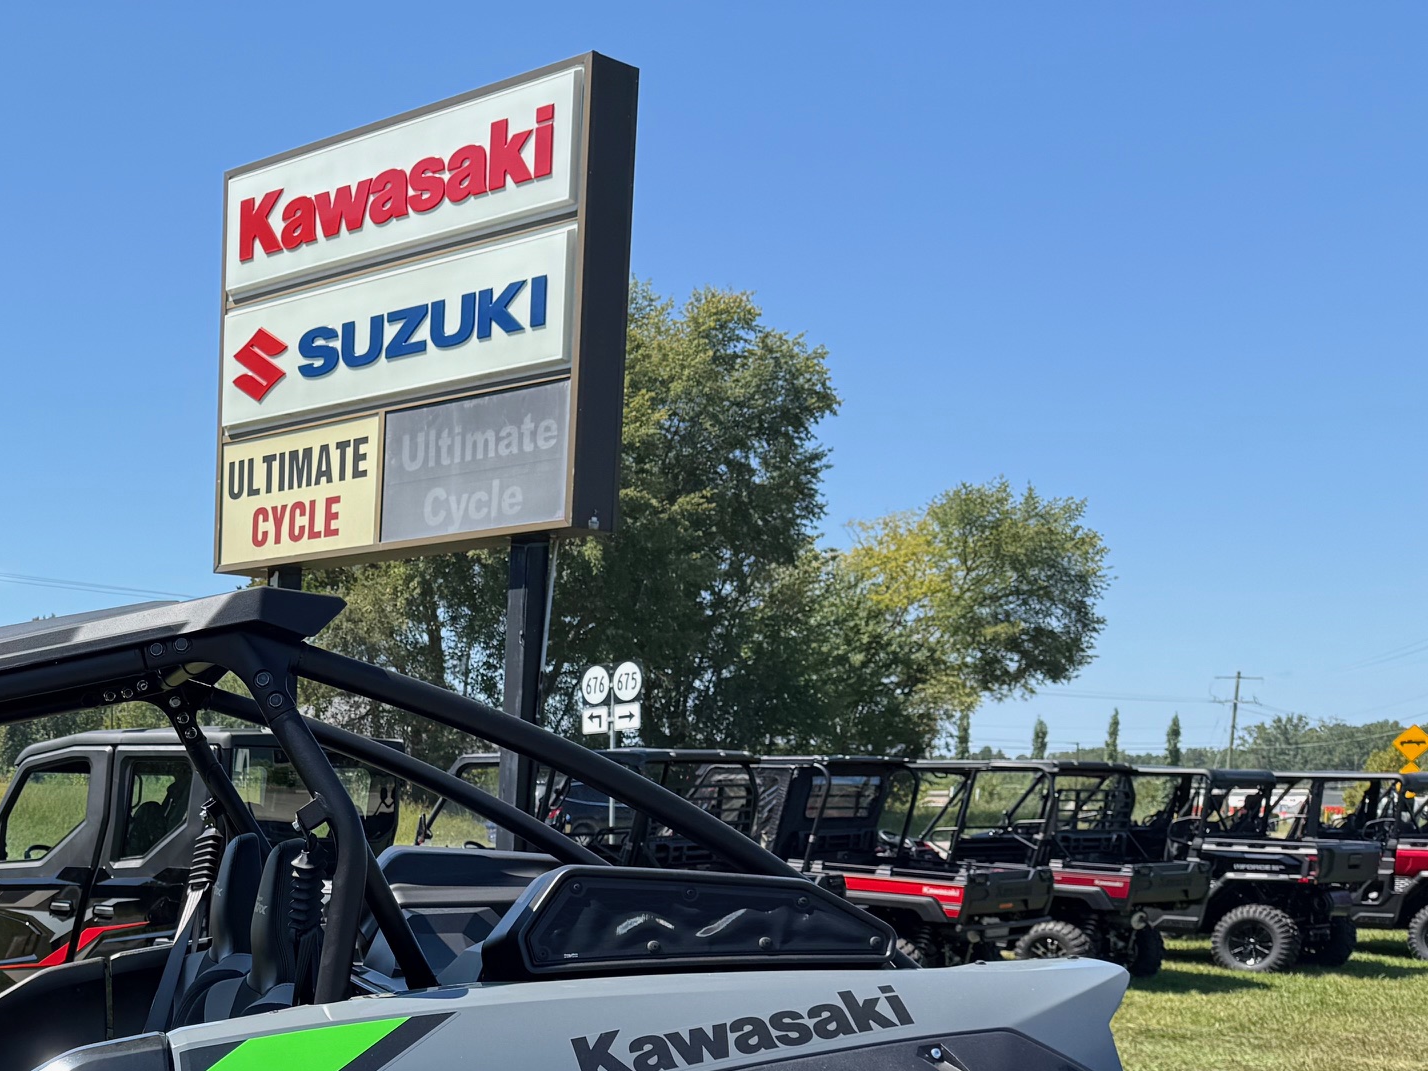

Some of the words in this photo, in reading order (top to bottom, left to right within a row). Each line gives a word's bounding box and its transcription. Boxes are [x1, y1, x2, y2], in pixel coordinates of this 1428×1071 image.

[238, 103, 556, 262] Kawasaki
[297, 274, 548, 378] SUZUKI
[228, 436, 369, 501] ULTIMATE
[402, 413, 558, 472] Ultimate
[251, 496, 341, 548] CYCLE
[423, 479, 523, 533] Cycle
[585, 676, 605, 695] 676
[617, 672, 637, 691] 675
